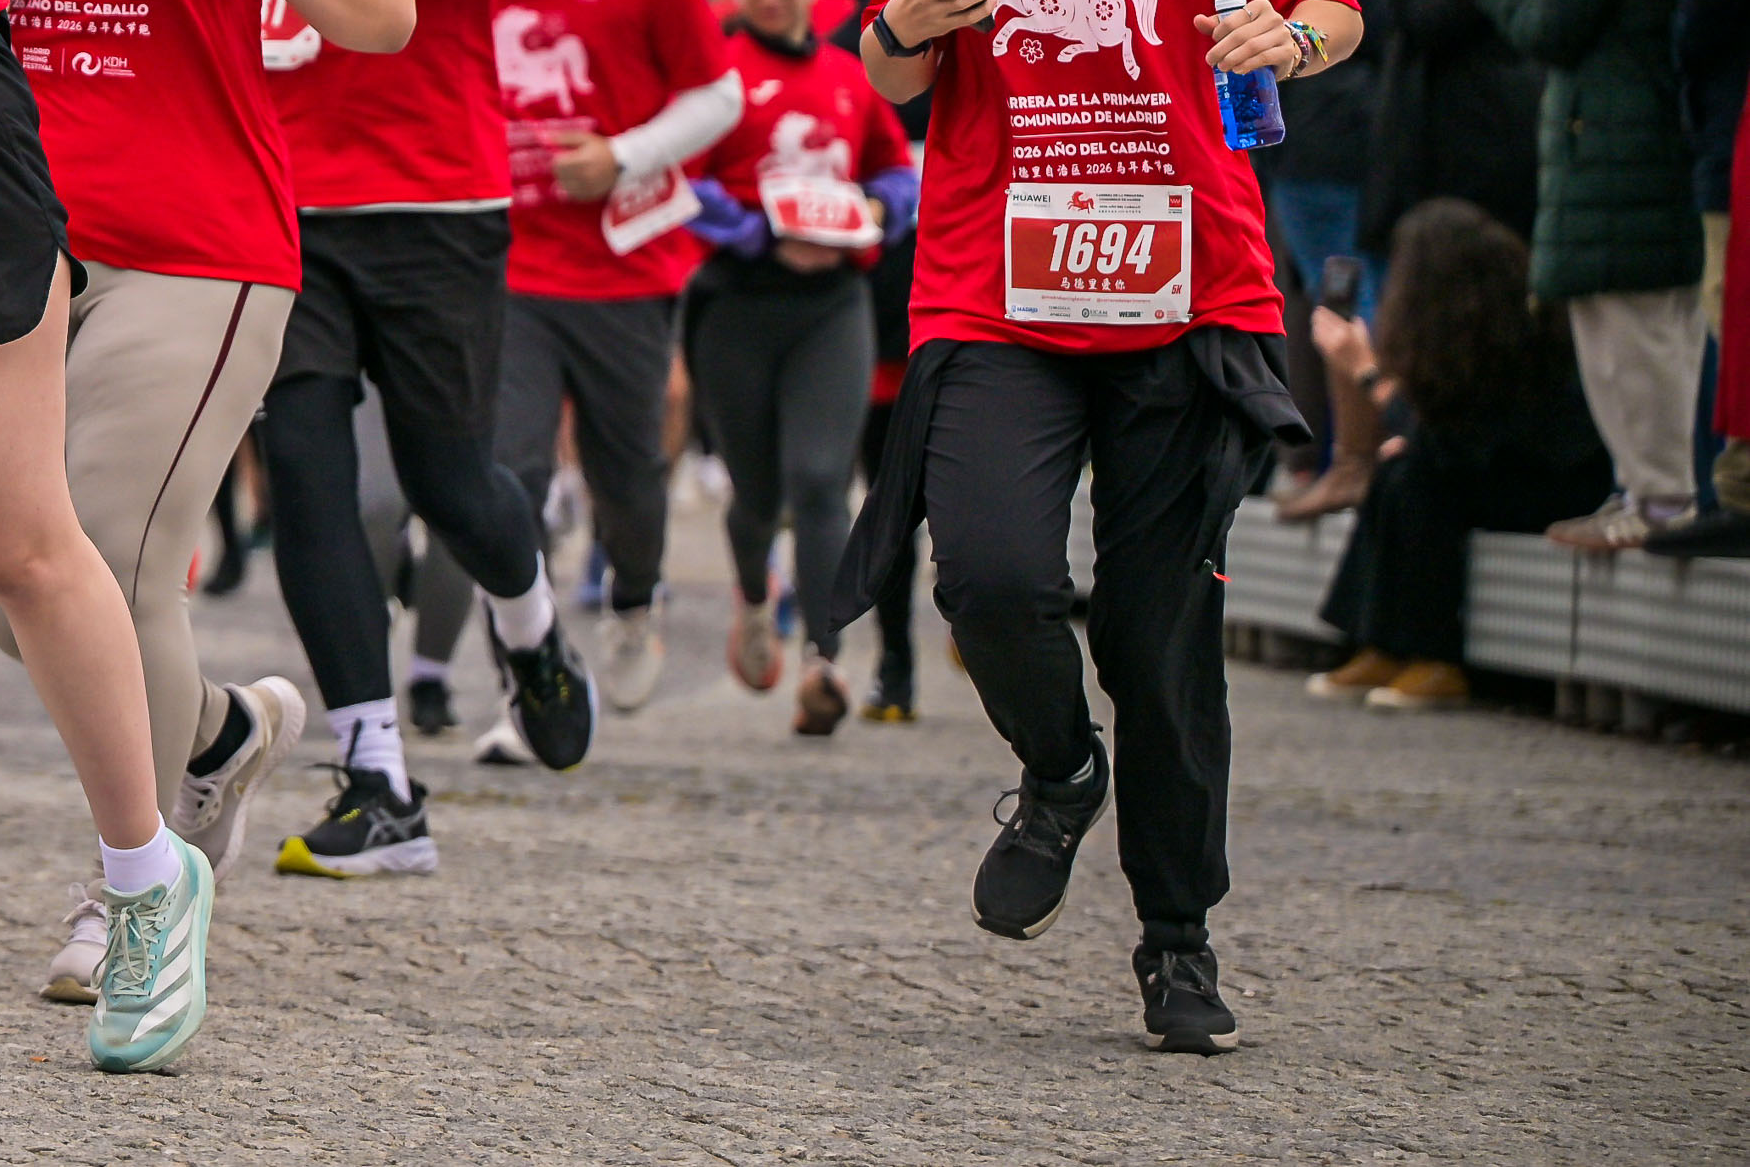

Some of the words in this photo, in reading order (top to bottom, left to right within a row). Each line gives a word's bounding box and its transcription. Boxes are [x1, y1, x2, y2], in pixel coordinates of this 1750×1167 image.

[54, 0, 81, 13] DEL
[83, 2, 149, 16] CABALLO
[57, 19, 83, 31] 2026
[103, 56, 128, 68] KDH
[1006, 96, 1056, 109] RRERA
[1058, 93, 1078, 107] DE
[1081, 92, 1100, 106] LA
[1102, 92, 1172, 106] PRIMAVERA
[1094, 110, 1112, 123] DE
[1114, 111, 1167, 125] MADRID
[1044, 141, 1077, 158] AÑO
[1079, 142, 1107, 156] DEL
[1086, 162, 1113, 175] 2026
[1050, 223, 1156, 275] 1694
[1171, 284, 1183, 295] 5K
